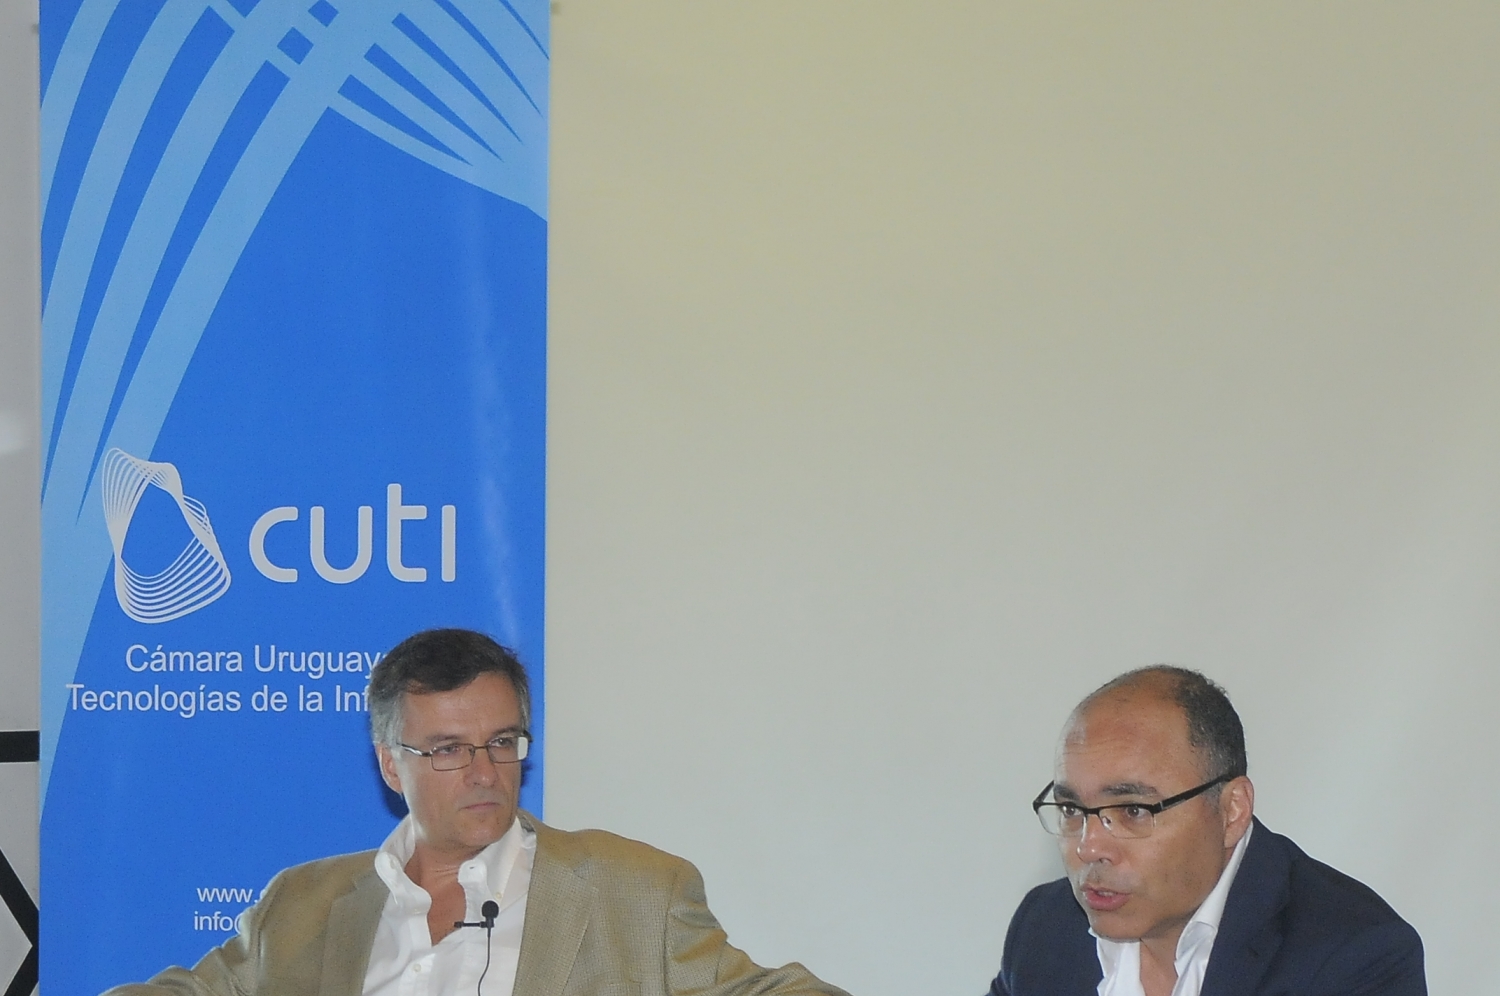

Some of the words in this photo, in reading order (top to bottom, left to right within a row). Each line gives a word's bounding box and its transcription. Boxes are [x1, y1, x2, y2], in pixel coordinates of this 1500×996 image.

[125, 644, 243, 673] Cámara
[254, 644, 387, 680] Uruguay
[66, 683, 241, 719] Tecnologías
[251, 685, 288, 712] de
[299, 684, 323, 712] la
